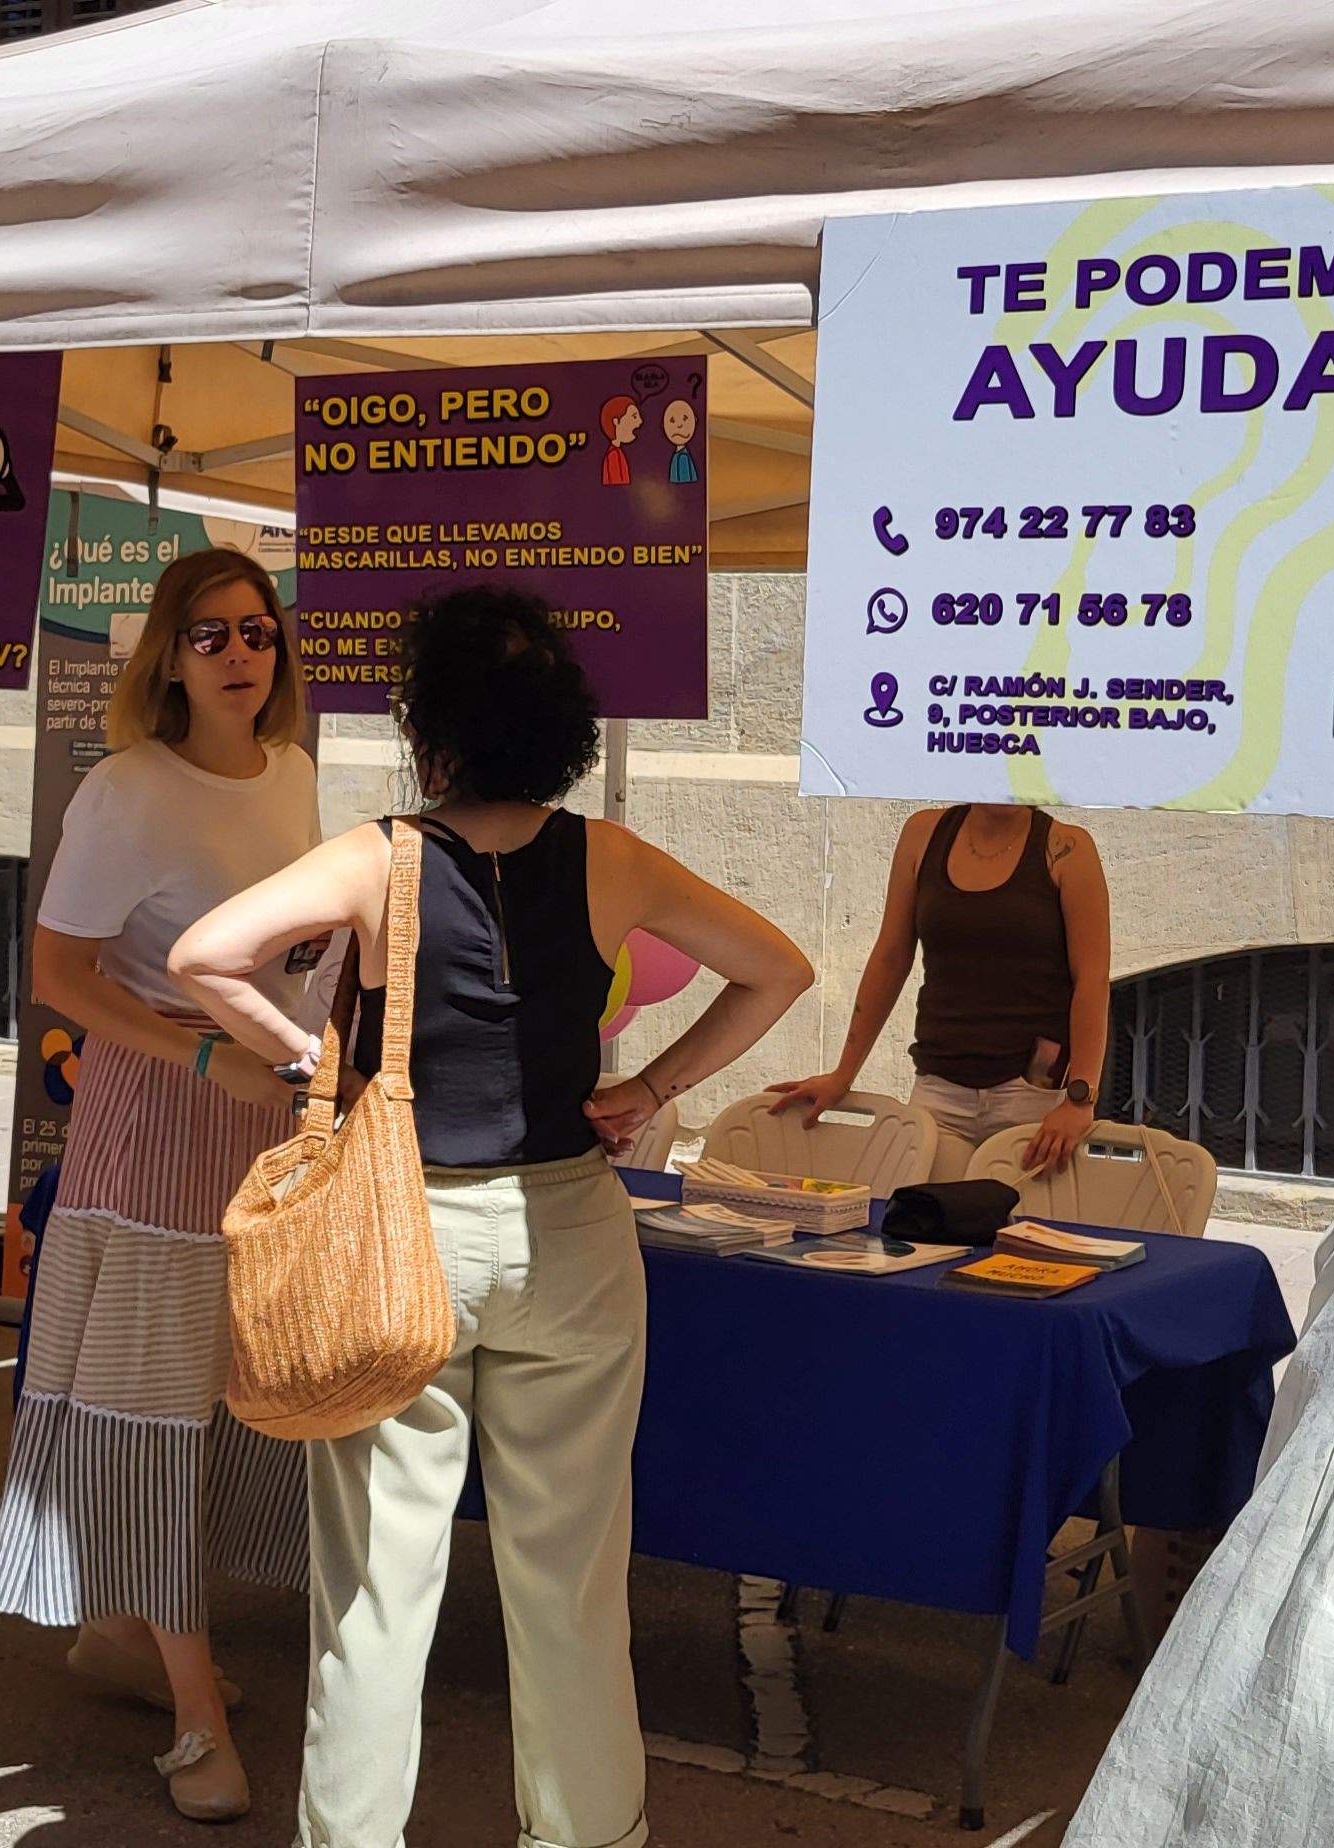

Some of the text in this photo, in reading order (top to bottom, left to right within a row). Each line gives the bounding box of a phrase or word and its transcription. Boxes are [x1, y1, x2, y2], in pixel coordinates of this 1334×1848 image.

[957, 261, 1048, 315] TE
[441, 386, 550, 421] PERO
[304, 442, 356, 473] NO
[386, 524, 432, 545] QUE
[439, 522, 562, 543] LLEVAMOS
[935, 504, 1197, 540] 974 22 77 83
[120, 542, 150, 563] es
[157, 534, 179, 562] el
[298, 548, 458, 571] MASCARILLAS,
[465, 548, 498, 568] NO
[505, 546, 625, 567] ENTIENDO
[49, 576, 155, 610] Implante
[931, 593, 1192, 627] 620 71 56 78
[300, 637, 402, 656] NO ME EN
[49, 660, 60, 676] El
[64, 660, 118, 682] Implante
[48, 680, 117, 694] técnica au
[928, 672, 1235, 706] C/ RAMÓN J. SENDER,
[46, 715, 75, 732] partir
[79, 715, 97, 731] de
[927, 703, 1217, 735] 9, POSTERIOR BAJO,
[927, 732, 1041, 755] HUESCA
[23, 1119, 35, 1134] El
[39, 1120, 56, 1137] 25
[21, 1140, 65, 1156] primer
